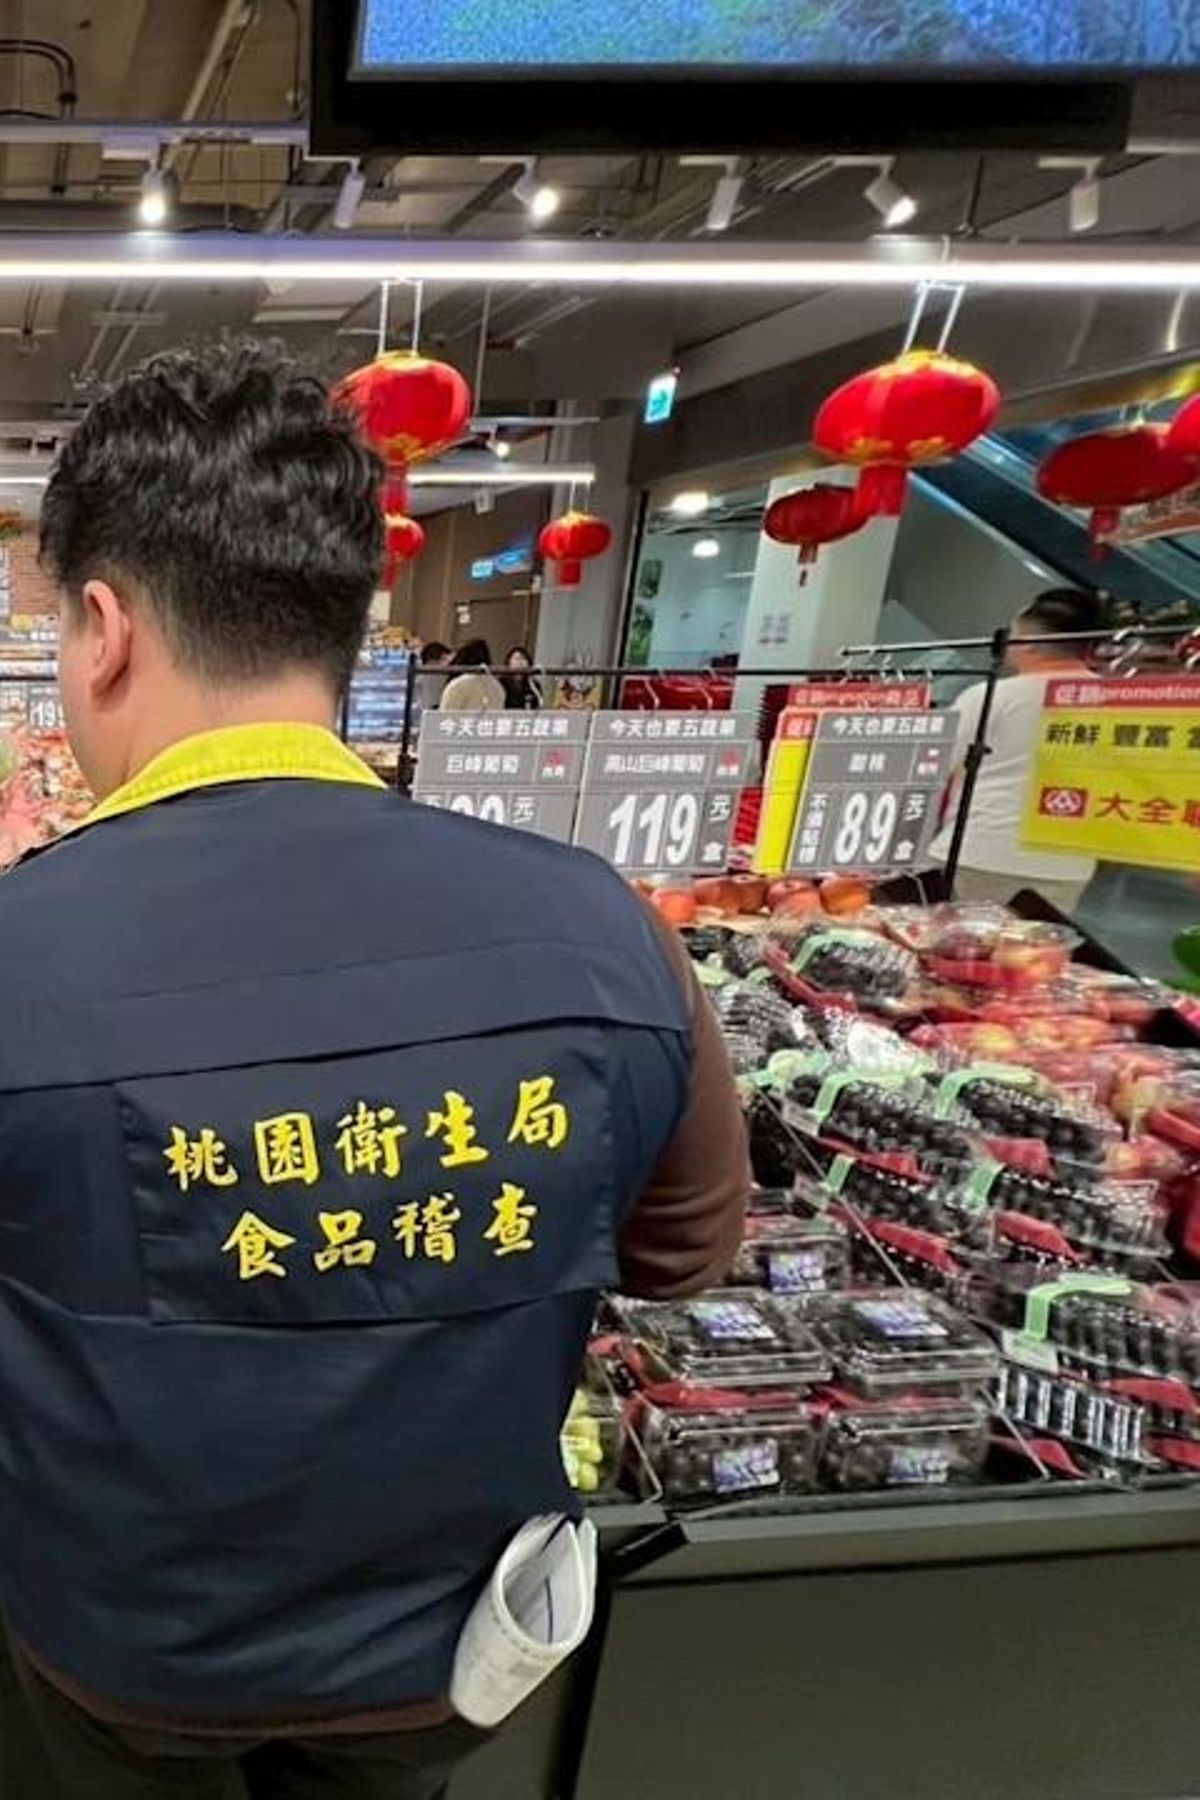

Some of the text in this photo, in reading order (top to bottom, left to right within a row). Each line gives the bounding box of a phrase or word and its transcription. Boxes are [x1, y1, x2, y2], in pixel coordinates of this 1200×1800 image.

[440, 719, 568, 736] 今天也要五蔬果
[610, 719, 736, 737] 今天也要五蔬果
[833, 717, 945, 734] 今天也要五蔬果
[1045, 723, 1100, 745] 新鮮
[1114, 724, 1174, 748] 豐富
[447, 754, 520, 773] 巨峰葡萄
[609, 794, 697, 865] 119
[834, 792, 897, 863] 89
[163, 1076, 568, 1192] 桃園衛生局
[221, 1182, 538, 1280] 食品稽查
